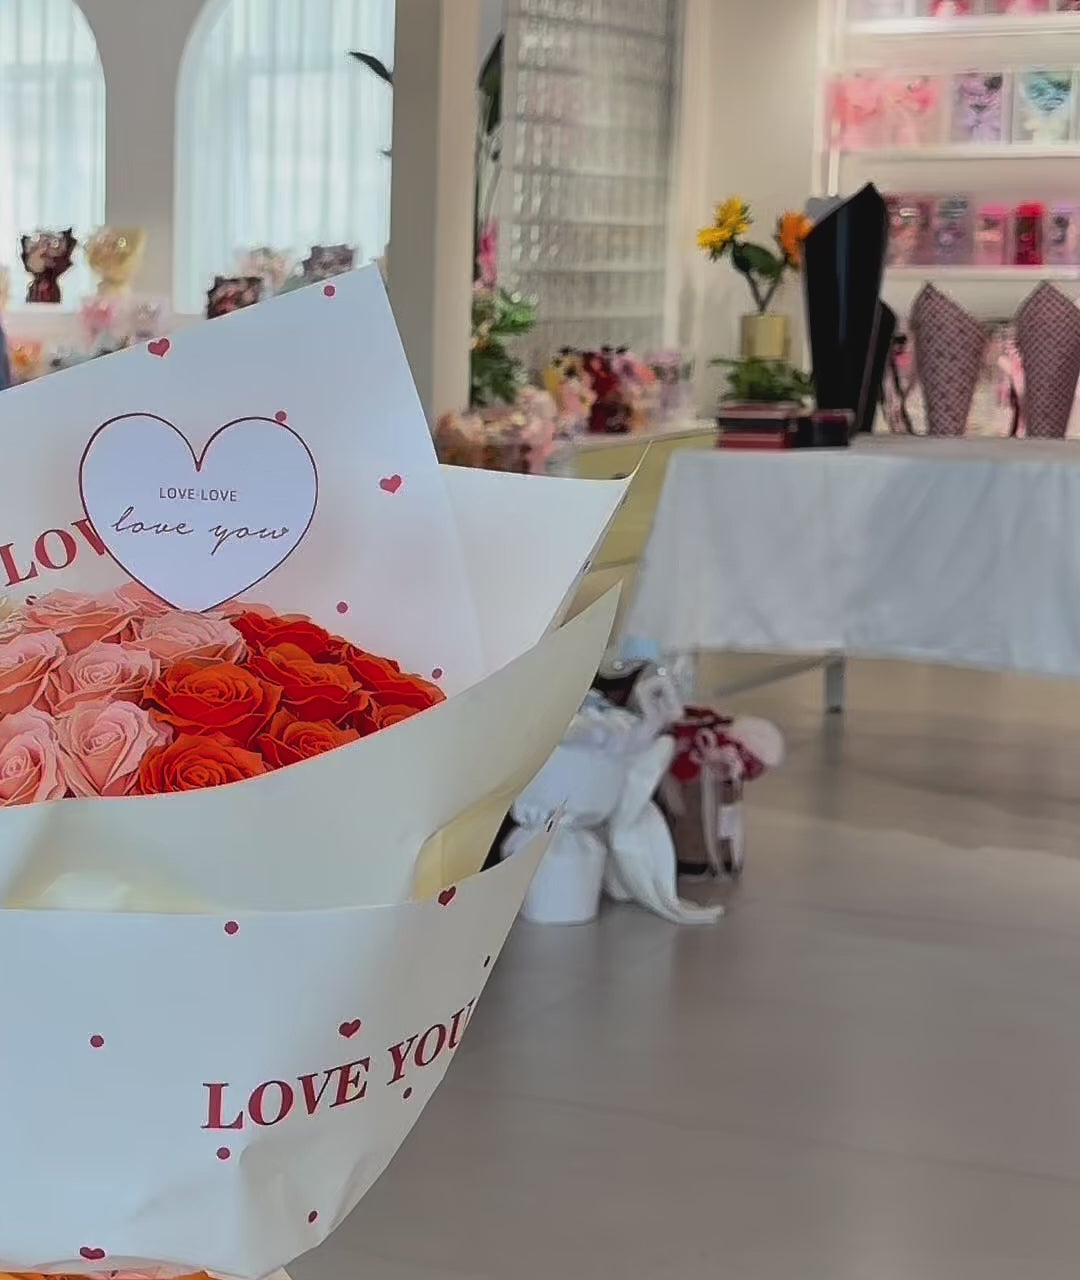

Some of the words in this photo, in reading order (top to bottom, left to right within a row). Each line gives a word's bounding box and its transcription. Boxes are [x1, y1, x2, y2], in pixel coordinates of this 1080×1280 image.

[111, 506, 194, 535] love
[208, 524, 289, 556] you
[200, 1056, 371, 1130] LOVE
